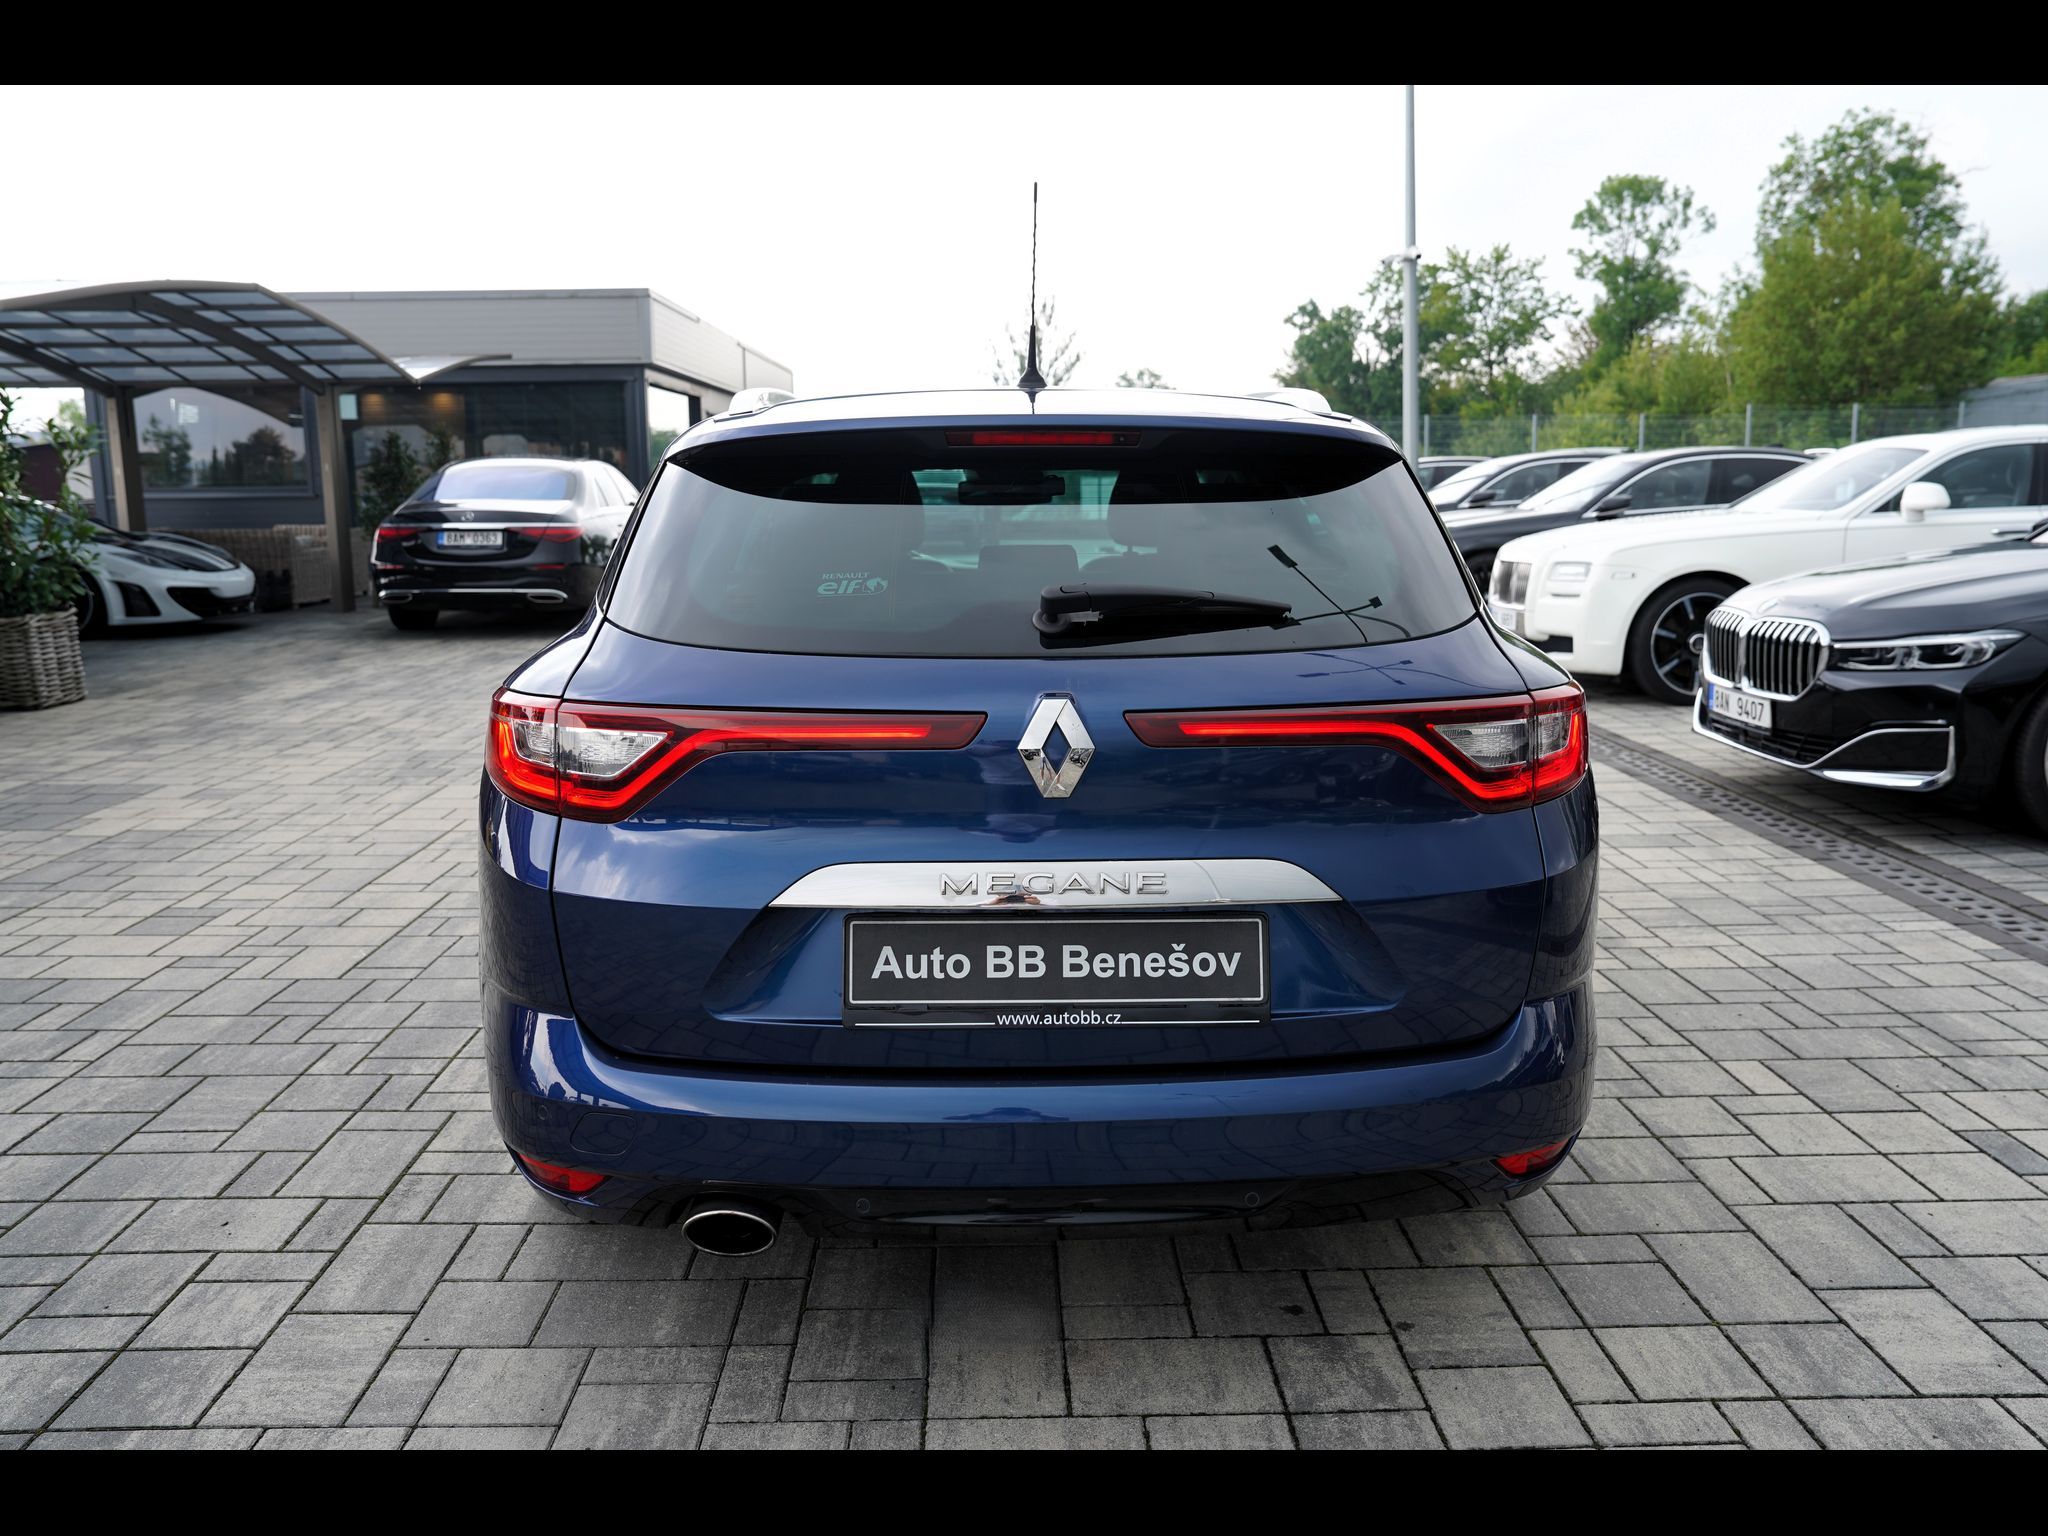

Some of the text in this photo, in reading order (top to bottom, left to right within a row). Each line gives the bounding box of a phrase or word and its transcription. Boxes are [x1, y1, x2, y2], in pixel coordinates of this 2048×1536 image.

[822, 572, 870, 580] RENAULT
[1736, 697, 1765, 722] 9407
[940, 872, 1169, 896] MEGANE
[871, 943, 1242, 979] Auto BB Benešov
[997, 1010, 1121, 1025] www.autobb.cz
